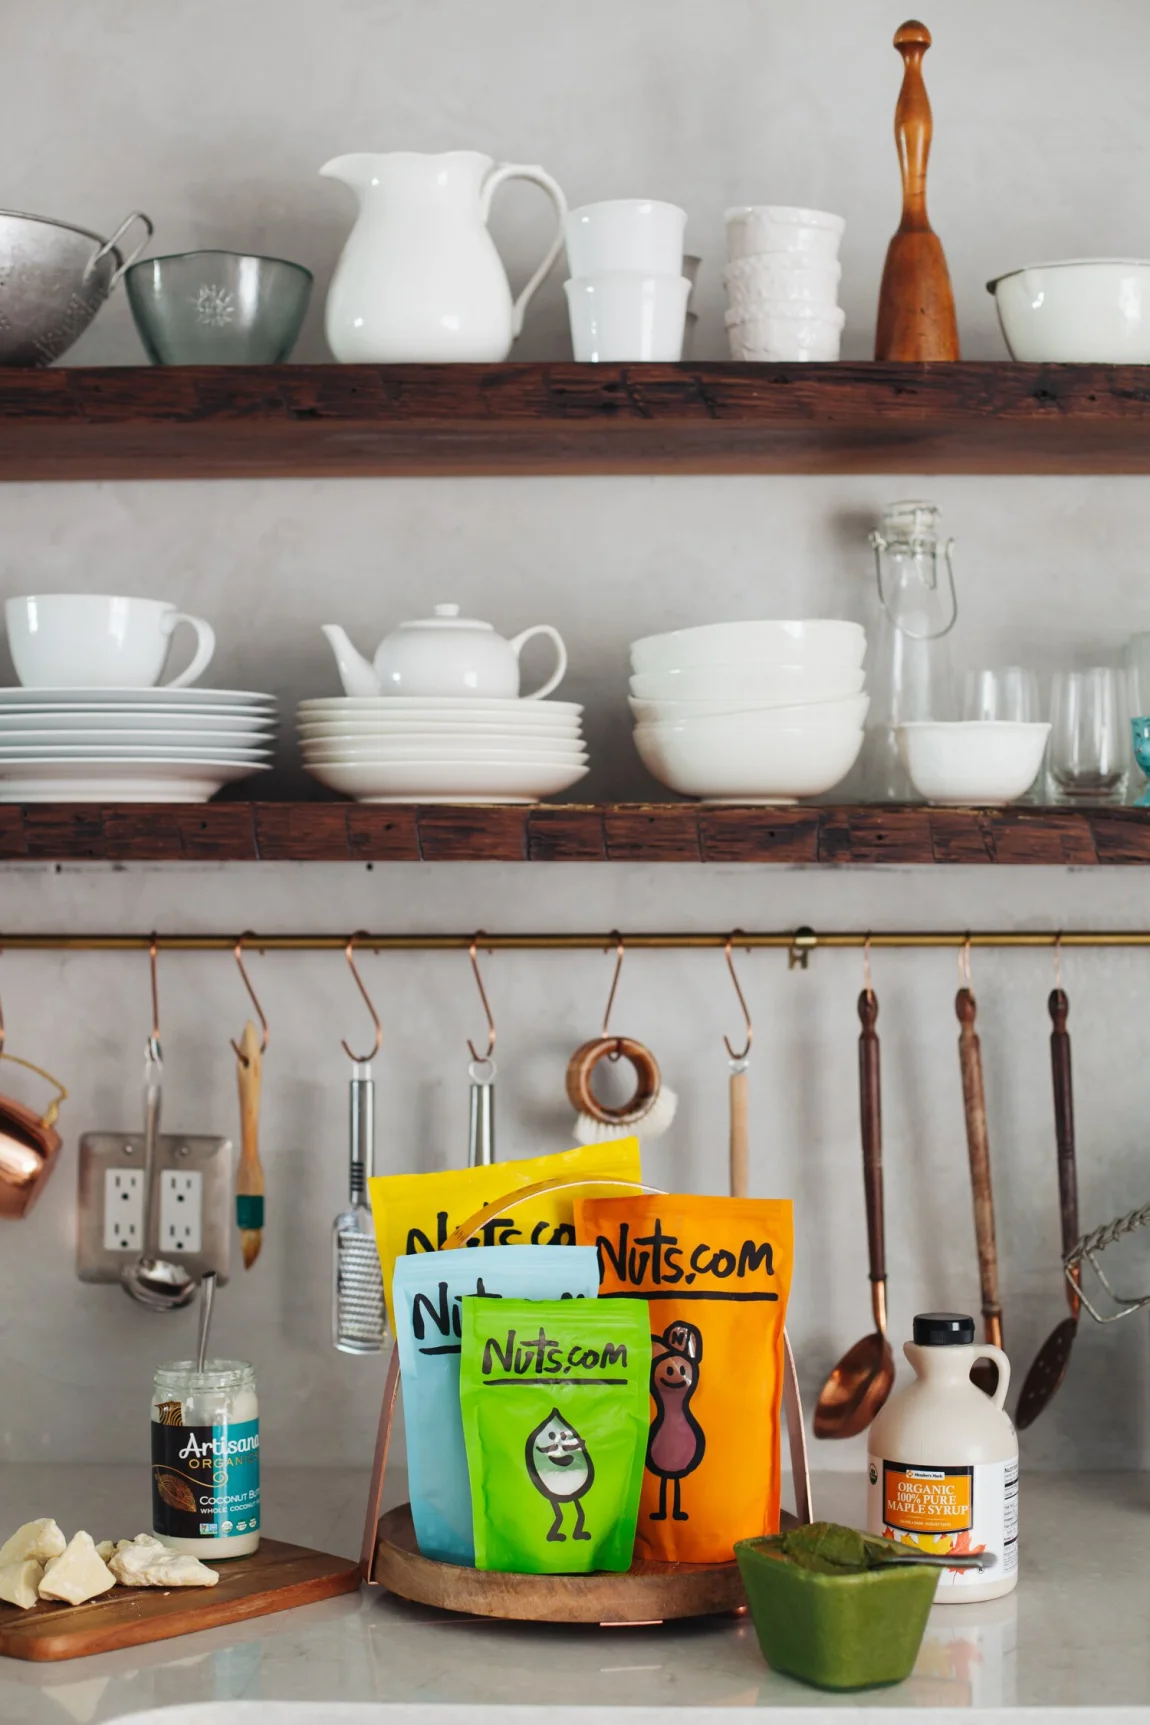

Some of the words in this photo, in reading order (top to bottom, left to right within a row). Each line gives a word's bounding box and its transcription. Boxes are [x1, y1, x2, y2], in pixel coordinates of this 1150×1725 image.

[898, 1482, 955, 1496] ORGANIC
[199, 1493, 248, 1506] COCONUT
[897, 1491, 920, 1504] 100%
[923, 1494, 957, 1506] PURE
[200, 1506, 228, 1515] WHOLE
[887, 1500, 925, 1514] MAPLE
[927, 1504, 969, 1516] SYRUP
